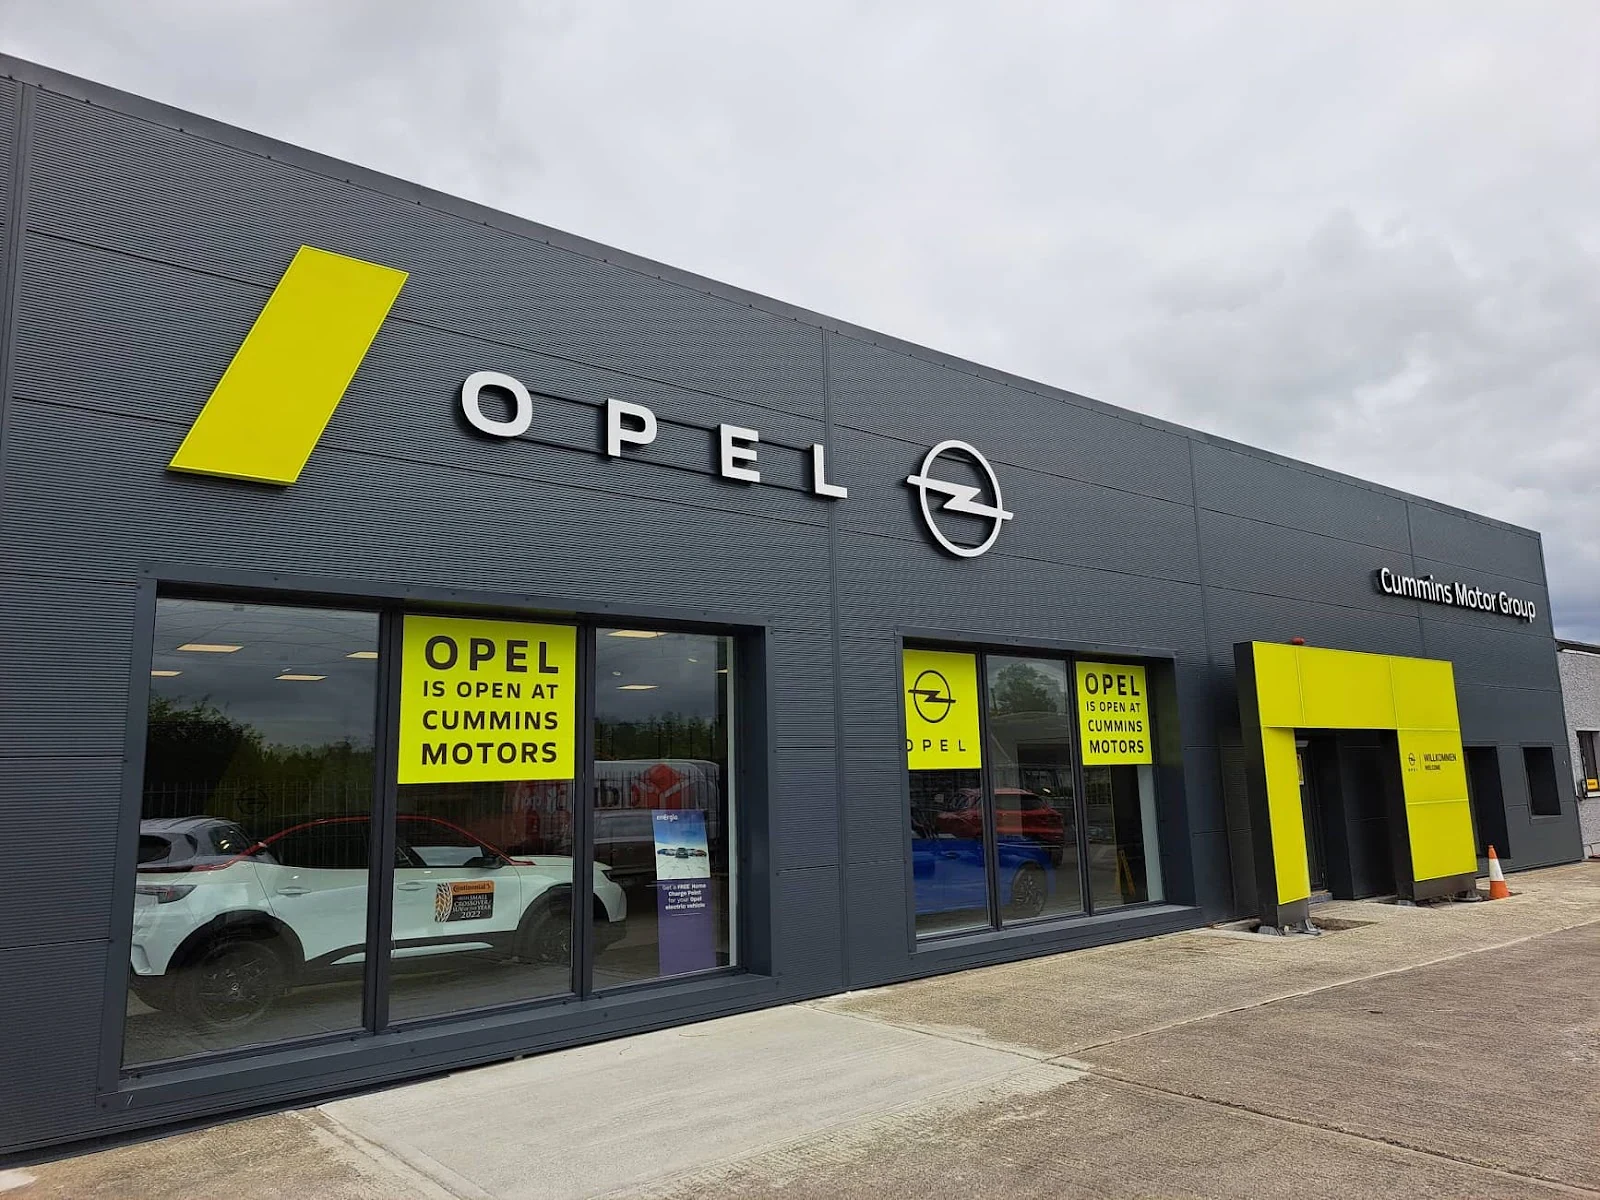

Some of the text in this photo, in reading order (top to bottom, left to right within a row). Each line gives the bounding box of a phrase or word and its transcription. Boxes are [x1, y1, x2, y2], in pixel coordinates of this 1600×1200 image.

[461, 371, 848, 499] OPEL
[1381, 568, 1536, 623] Cummins Motor Group
[425, 635, 559, 674] OPEL
[423, 680, 559, 699] IS OPEN AT
[1085, 672, 1140, 696] OPEL
[1086, 701, 1141, 712] IS OPEN AT
[422, 710, 558, 730] CUMMINS
[1088, 720, 1143, 732] CUMMINS
[421, 742, 557, 765] MOTORS
[1089, 740, 1144, 753] MOTORS
[1424, 753, 1457, 761] WILLKOMMEN
